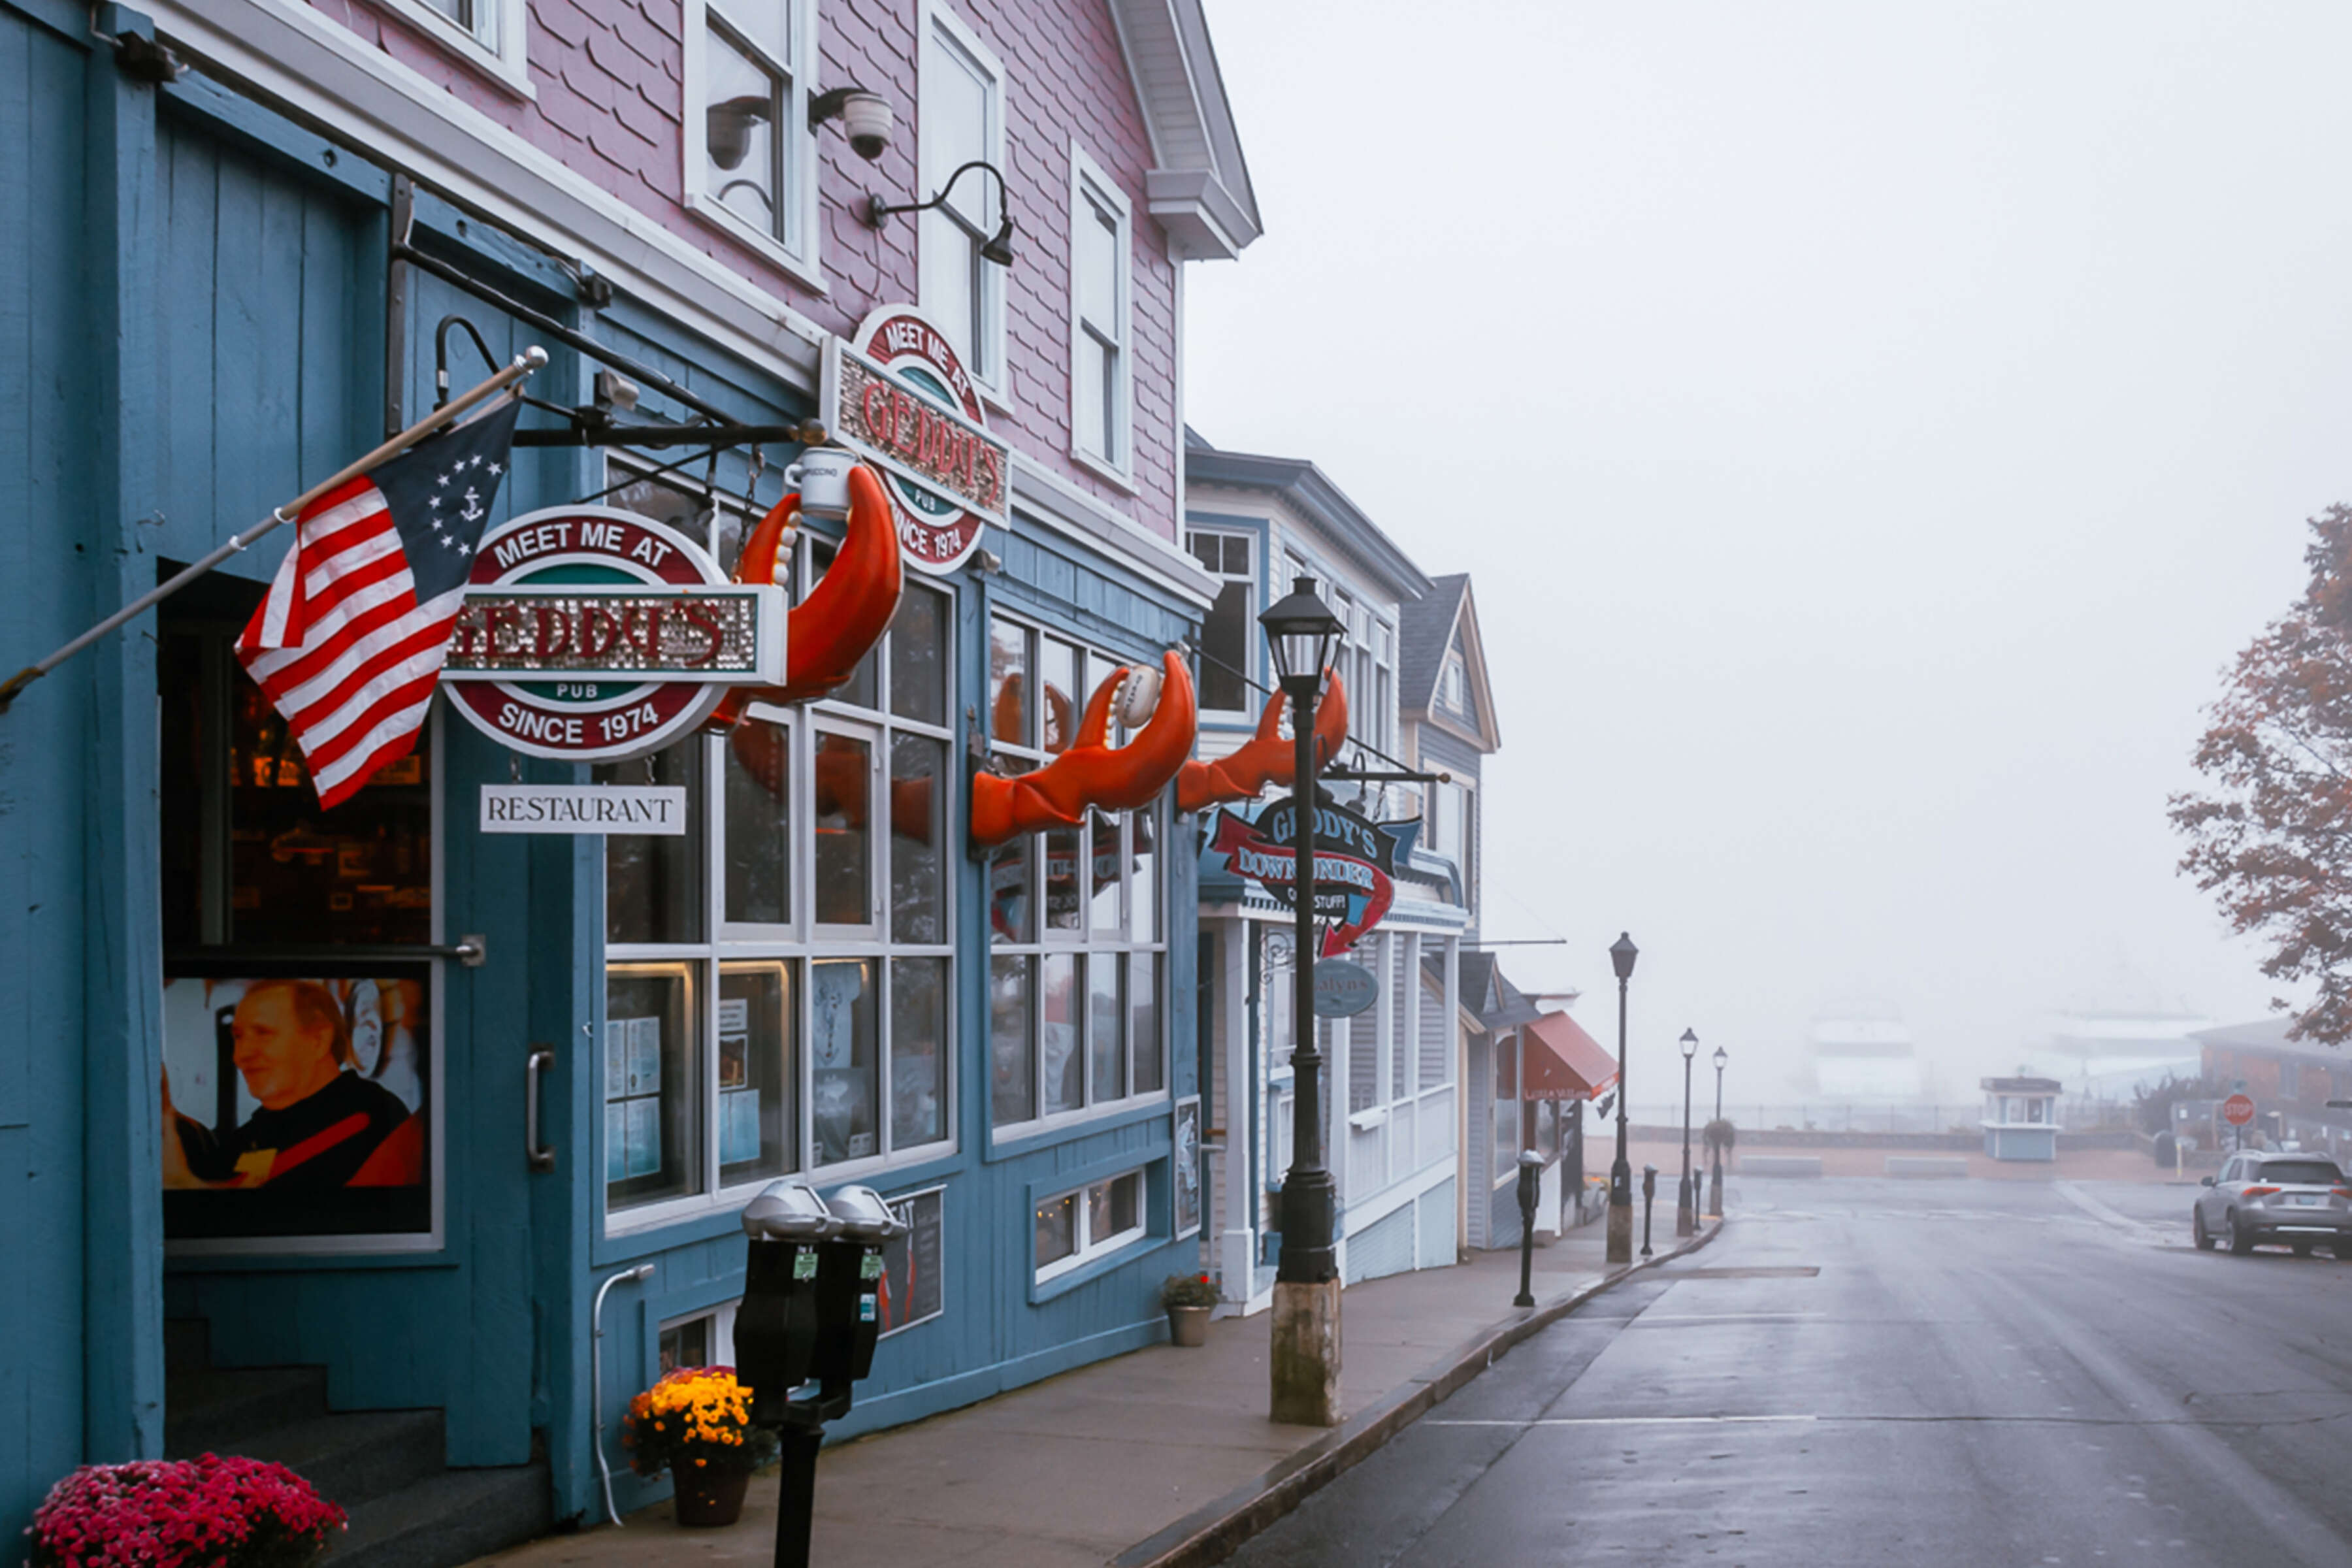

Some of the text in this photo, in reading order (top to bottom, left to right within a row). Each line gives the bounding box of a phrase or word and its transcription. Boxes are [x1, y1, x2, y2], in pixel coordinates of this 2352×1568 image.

[885, 323, 971, 399] MEET ME AT
[863, 380, 999, 506] GEDDY'S
[915, 489, 936, 511] PUB
[493, 522, 673, 568] MEET ME AT
[896, 509, 962, 558] NCE 1974
[557, 684, 598, 698] PUB
[498, 701, 659, 744] SINCE 1974
[487, 796, 674, 823] RESTAURANT
[2224, 1103, 2252, 1116] STOP
